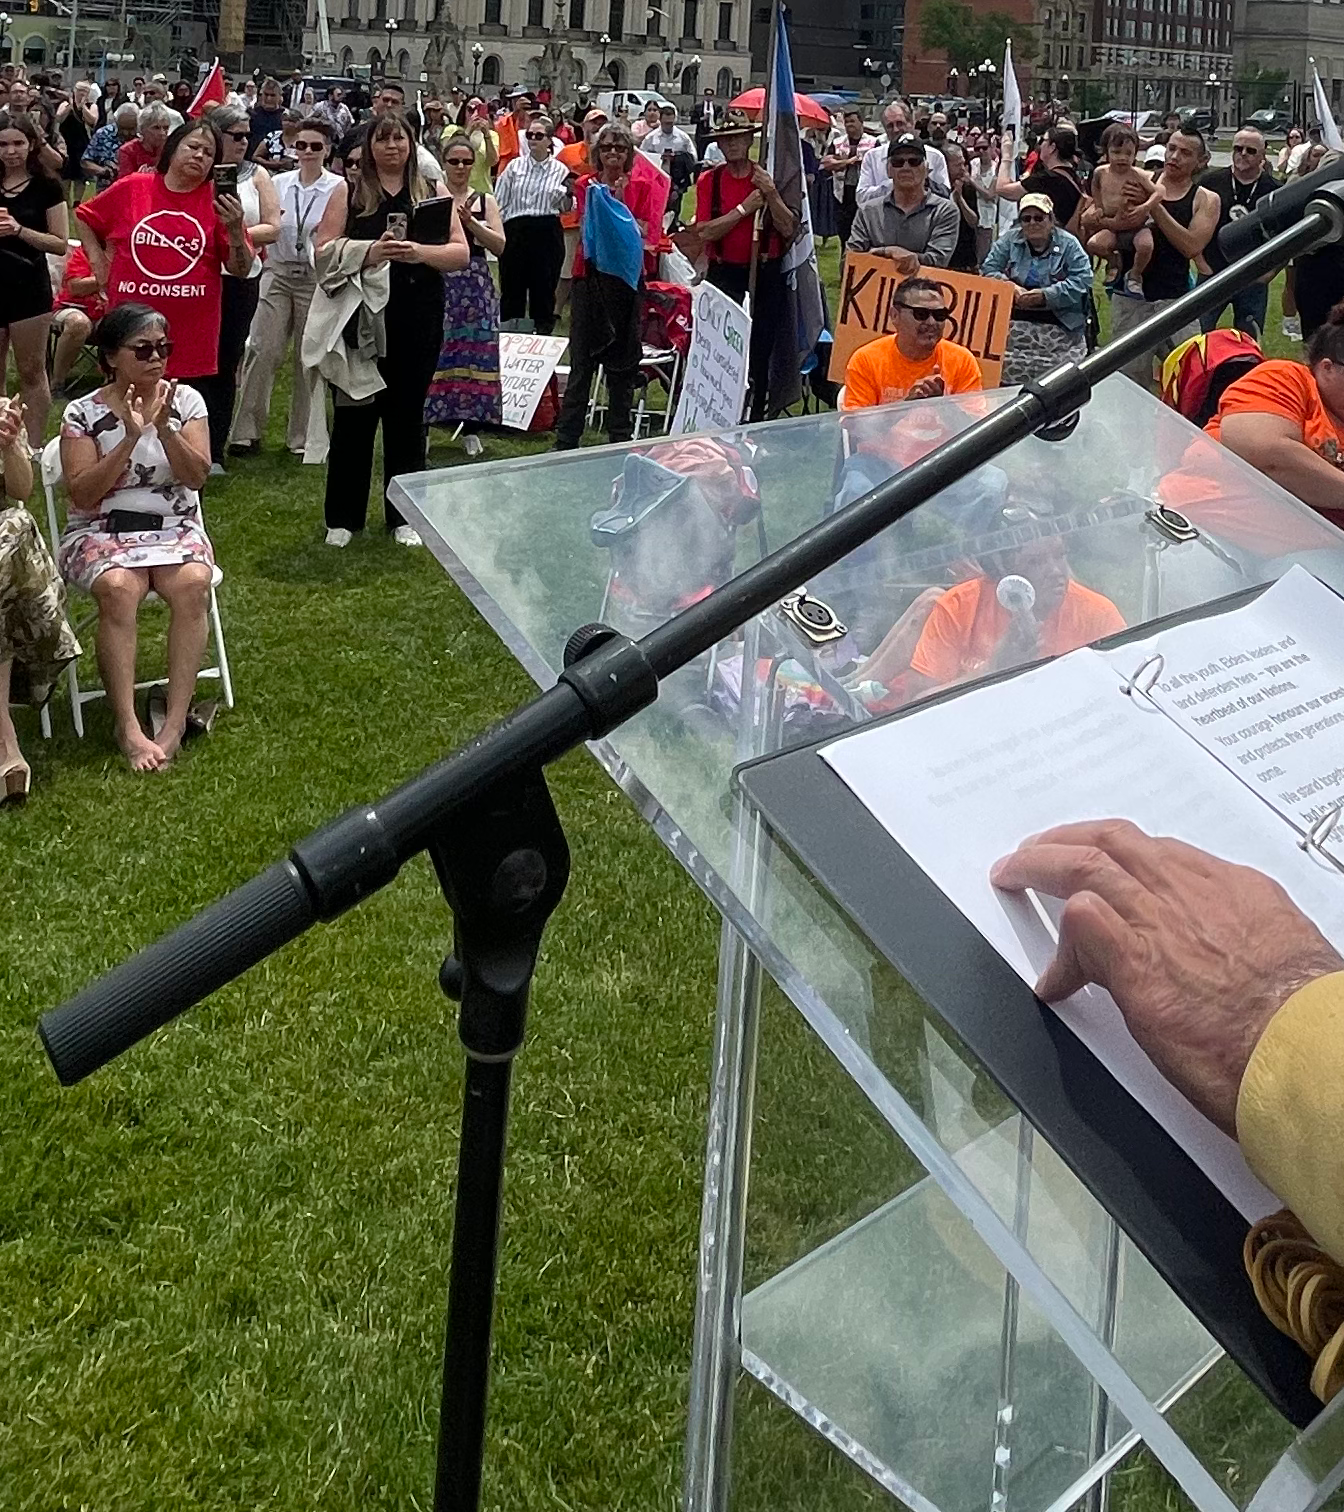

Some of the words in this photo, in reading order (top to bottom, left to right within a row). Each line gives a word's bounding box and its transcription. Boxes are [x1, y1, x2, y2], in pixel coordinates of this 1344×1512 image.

[135, 231, 169, 248] BILL
[173, 235, 200, 251] C-5
[118, 281, 136, 294] NO
[138, 282, 207, 298] CONSENT
[839, 264, 897, 335] KIL
[504, 356, 545, 374] WATER
[1191, 701, 1240, 727] heartbeat
[1214, 730, 1241, 747] Your
